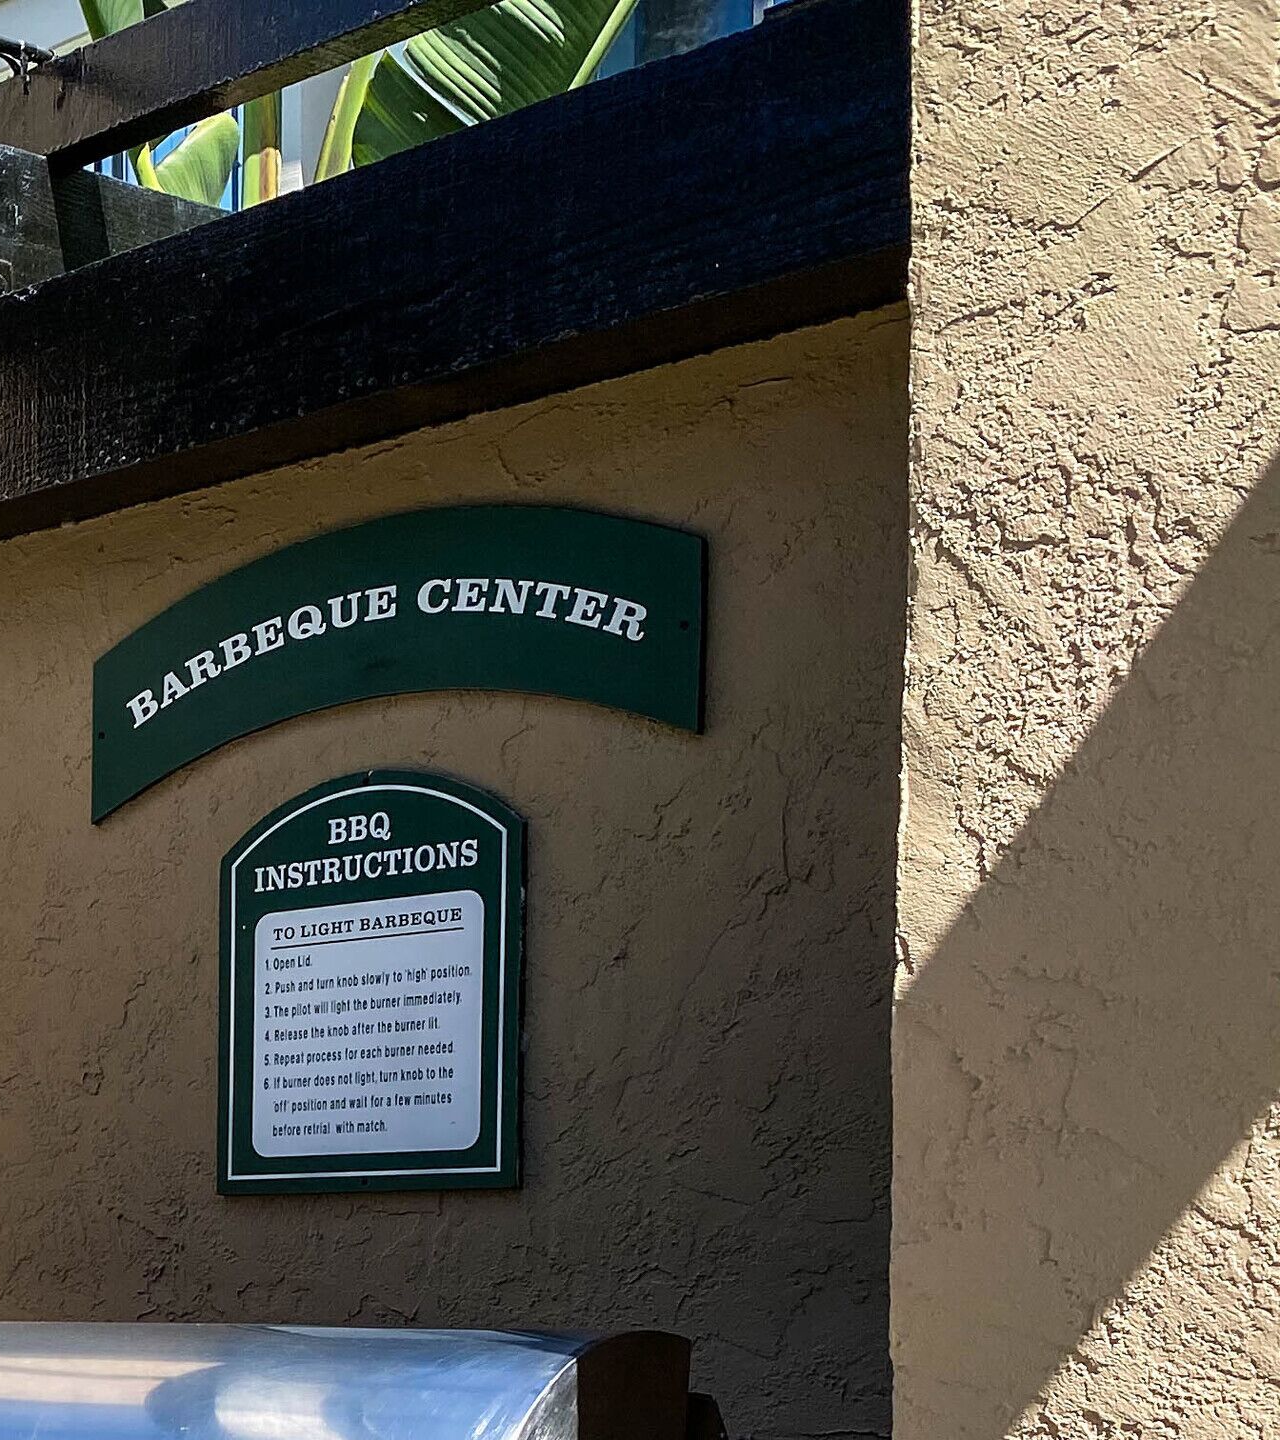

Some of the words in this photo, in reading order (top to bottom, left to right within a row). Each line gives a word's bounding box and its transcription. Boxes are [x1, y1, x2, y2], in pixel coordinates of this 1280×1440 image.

[125, 584, 398, 730] BARBEQUE
[417, 578, 648, 642] CENTER
[327, 811, 391, 845] BBQ
[254, 839, 479, 892] INSTRUCTIONS
[273, 927, 295, 941] TO
[300, 919, 354, 938] LIGHT
[359, 907, 462, 932] BARBEQUE
[273, 957, 295, 971] Open
[275, 981, 295, 994] Push
[298, 978, 314, 992] and
[316, 978, 334, 990] turn
[337, 975, 359, 988] knob
[361, 971, 390, 986] slowly
[392, 970, 403, 983] to
[430, 964, 472, 982] position.
[274, 1005, 289, 1018] The
[291, 1003, 311, 1018] pilot
[314, 1001, 329, 1014] will
[330, 999, 350, 1015] light
[353, 998, 368, 1011] the
[370, 997, 401, 1009] burner
[403, 990, 462, 1006] immediately.
[274, 1029, 308, 1042] Release
[311, 1027, 325, 1039] the
[327, 1024, 349, 1037] knob
[352, 1021, 375, 1035] after
[377, 1021, 392, 1034] the
[394, 1019, 426, 1032] burner
[274, 1052, 304, 1067] Repeat
[306, 1050, 342, 1065] process
[345, 1047, 357, 1060] for
[360, 1045, 382, 1059] each
[384, 1045, 415, 1058] burner
[273, 1076, 280, 1089] If
[282, 1076, 311, 1089] burner
[313, 1074, 335, 1087] does
[338, 1072, 352, 1085] not
[379, 1069, 398, 1083] turn
[400, 1068, 424, 1081] knob
[426, 1067, 436, 1080] to
[438, 1066, 454, 1079] the
[291, 1098, 327, 1114] position
[330, 1097, 346, 1110] and
[349, 1095, 368, 1108] wait
[370, 1094, 384, 1108] for
[386, 1096, 391, 1106] a
[395, 1093, 411, 1106] few
[413, 1092, 452, 1105] minutes
[272, 1124, 301, 1136] before
[303, 1121, 330, 1135] retrial
[336, 1121, 354, 1134] with
[357, 1119, 387, 1133] match.
